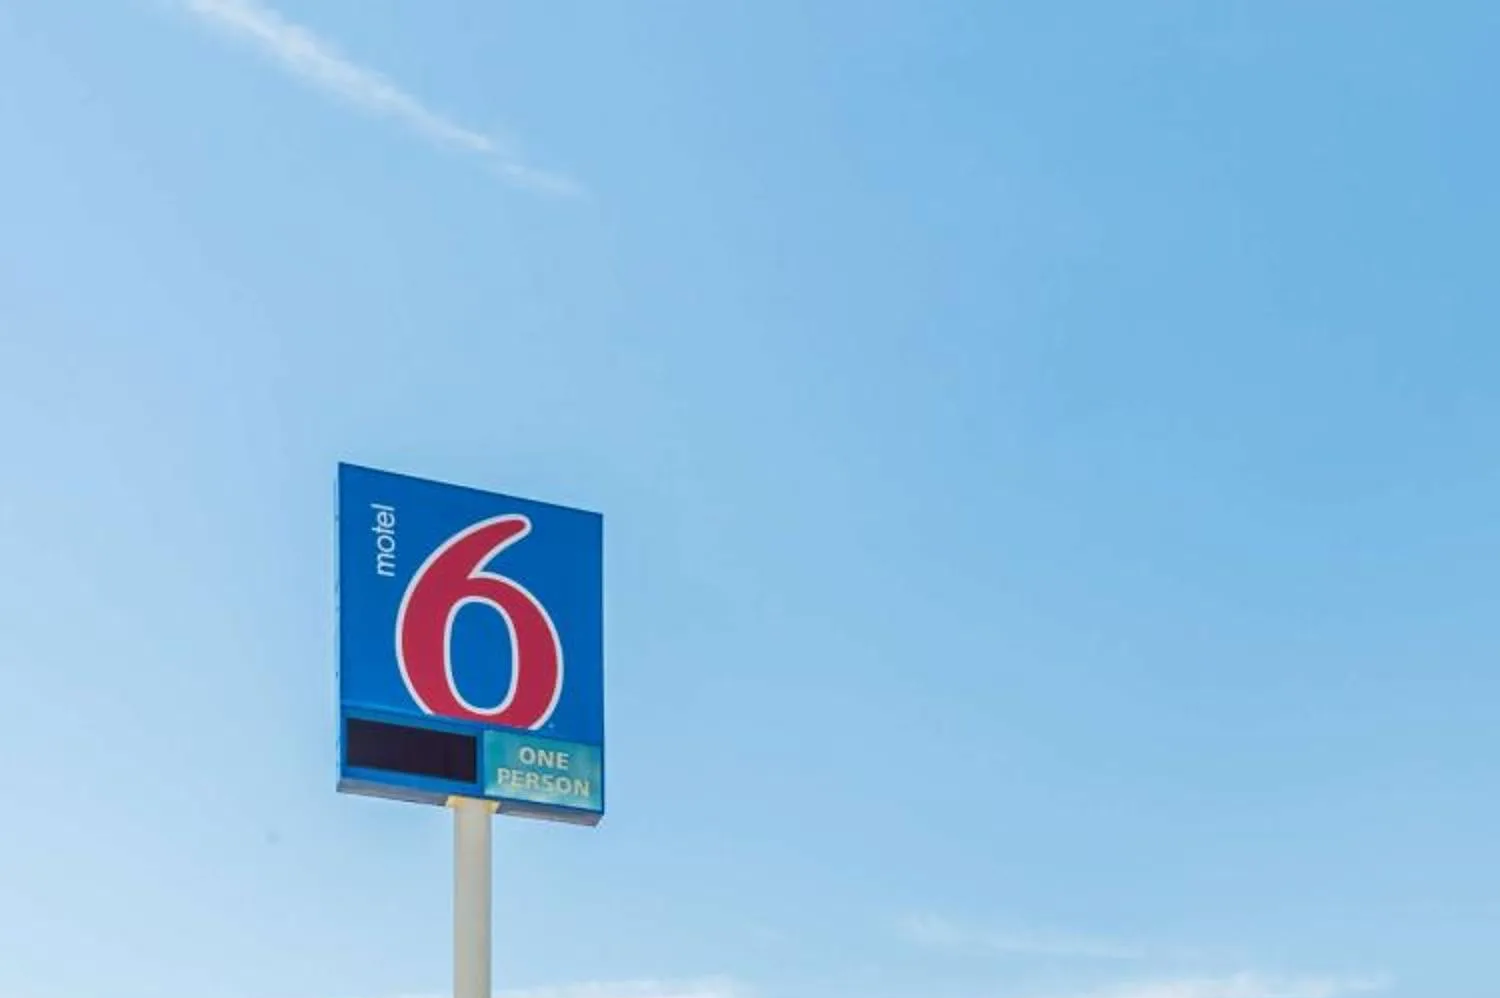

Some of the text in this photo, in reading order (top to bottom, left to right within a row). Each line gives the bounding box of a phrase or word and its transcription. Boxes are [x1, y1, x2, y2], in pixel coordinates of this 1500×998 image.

[371, 503, 396, 578] motel
[395, 513, 564, 730] 6
[496, 767, 590, 797] PERSON
[519, 746, 569, 770] ONE
